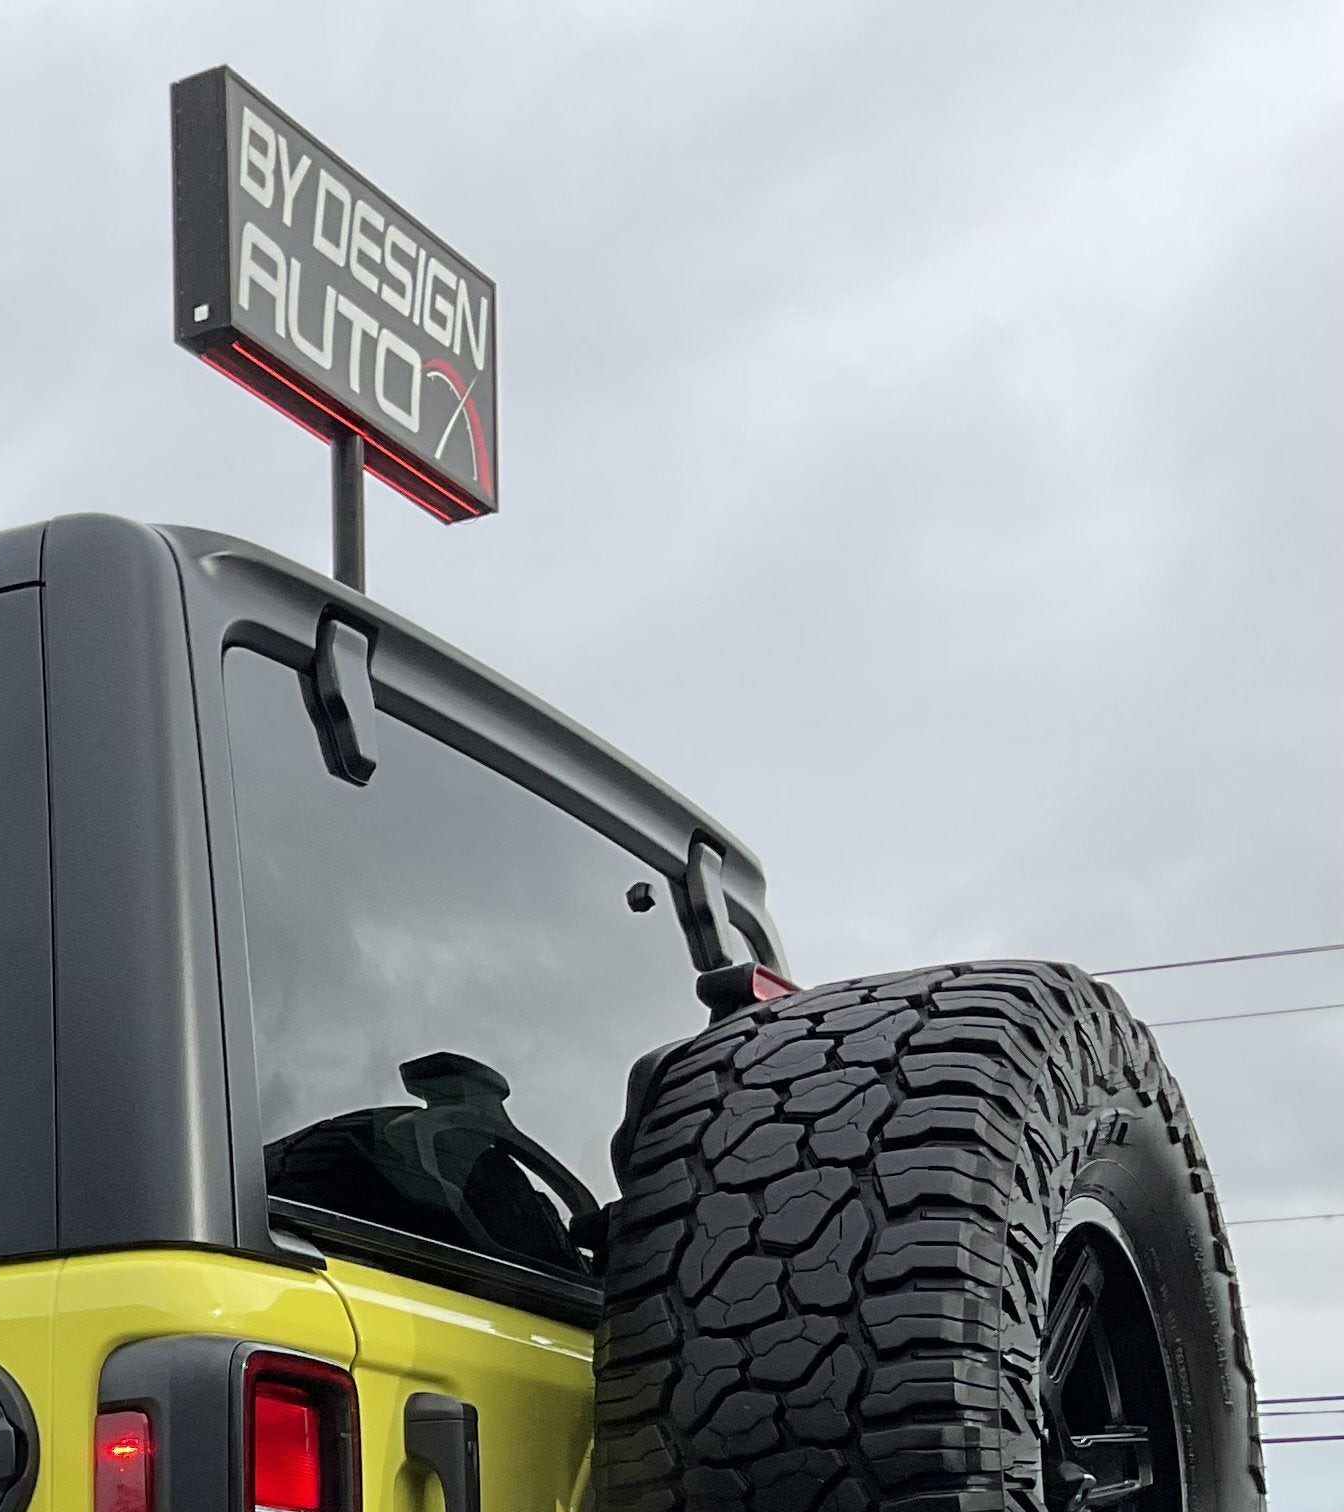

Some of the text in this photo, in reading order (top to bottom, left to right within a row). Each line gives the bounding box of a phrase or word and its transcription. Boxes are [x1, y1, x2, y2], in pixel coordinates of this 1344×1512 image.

[238, 221, 422, 433] AUTO
[239, 105, 489, 372] BY DESIGN
